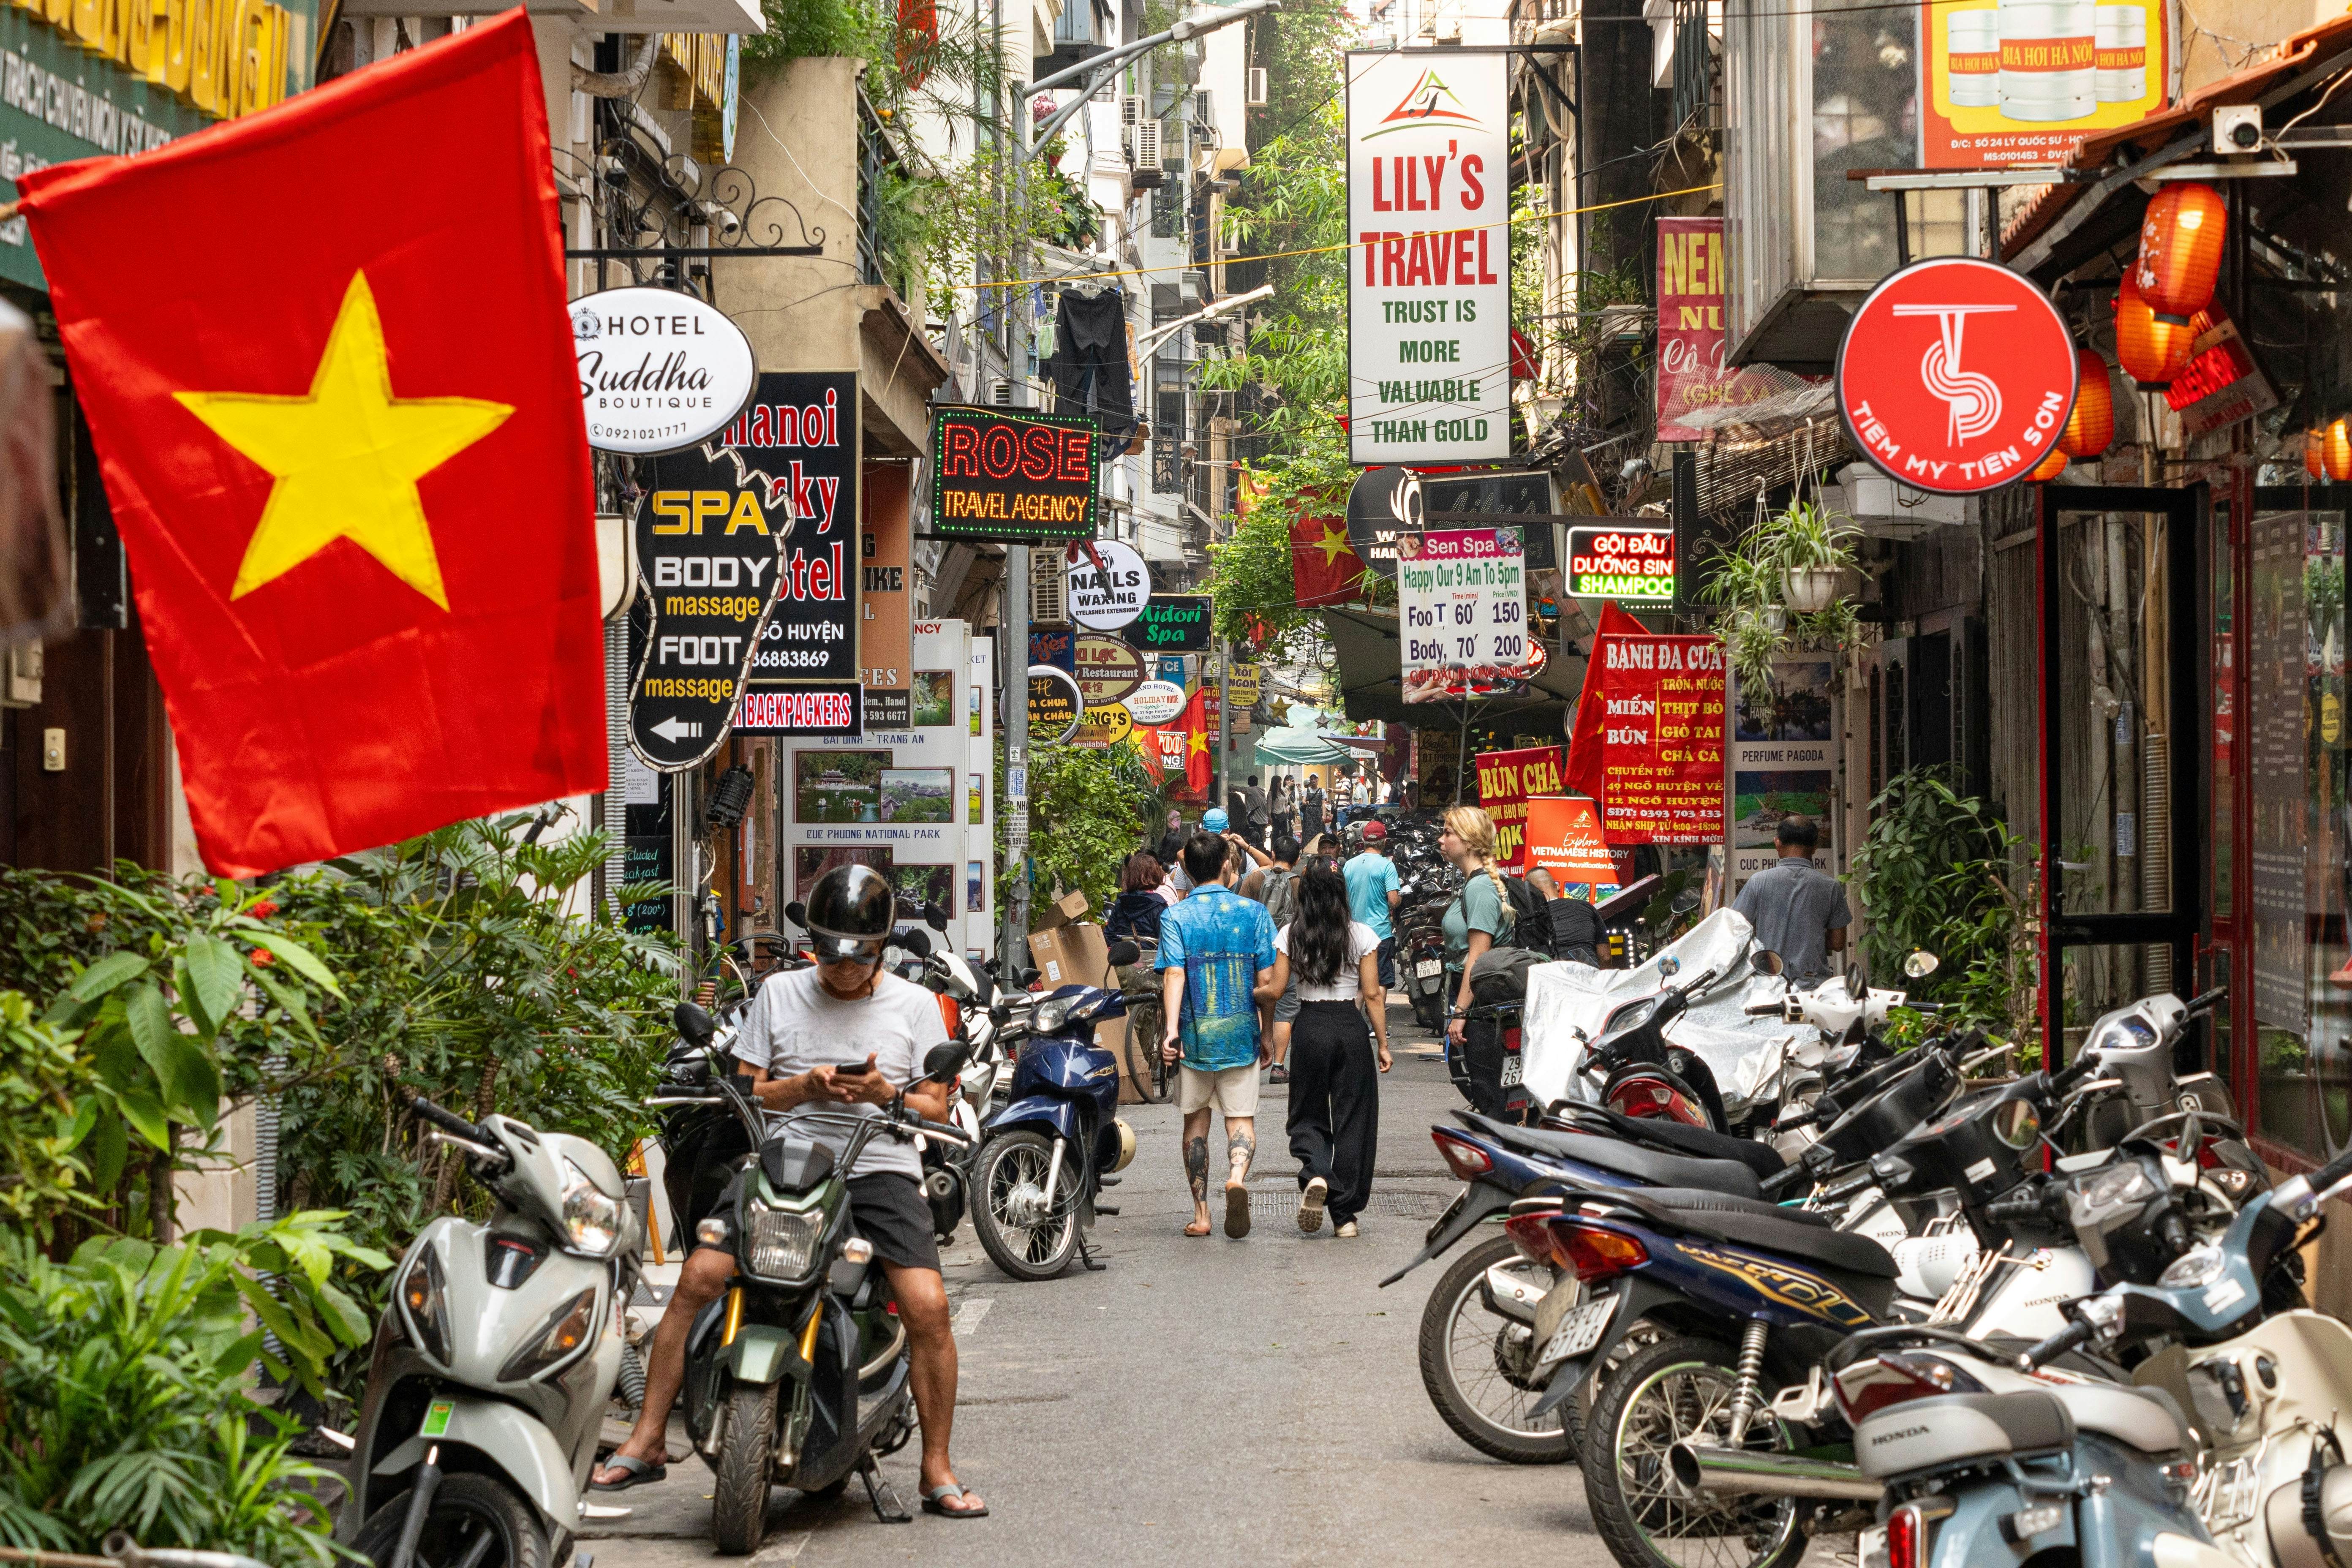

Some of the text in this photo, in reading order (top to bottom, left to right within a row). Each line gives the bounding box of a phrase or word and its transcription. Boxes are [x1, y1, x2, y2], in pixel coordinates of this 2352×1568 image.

[1950, 57, 1962, 69] BIA
[1982, 54, 1993, 69] HÀ
[2003, 40, 2092, 67] BIA HƠI HÀ NỘI
[2117, 49, 2128, 65] HÀ
[2130, 48, 2144, 66] NỘI
[1951, 139, 1971, 148] Đ/C:
[1975, 136, 1989, 147] SỐ
[2004, 136, 2015, 146] LÝ
[2018, 135, 2046, 145] QUỐC
[2048, 135, 2062, 144] SƯ
[1984, 152, 2038, 161] MS:0101453
[1373, 139, 1484, 211] LILY'S
[1360, 230, 1497, 287] TRAVEL
[1382, 299, 1476, 323] TRUST IS
[608, 316, 705, 335] HOTEL
[1399, 340, 1460, 363] MORE
[577, 351, 713, 399] Suddha
[1378, 379, 1481, 403] VALUABLE
[600, 397, 711, 408] BOUTIQUE
[606, 422, 686, 439] 0921021777
[1371, 419, 1488, 443] THAN GOLD
[943, 424, 1089, 481] ROSE
[653, 490, 771, 536] SPA
[944, 491, 1088, 522] TRAVEL AGENCY
[1427, 537, 1495, 558] Sen Spa
[1594, 533, 1625, 555] GỘI
[655, 557, 772, 587] BODY
[1573, 554, 1640, 574] DƯỠNG
[1404, 561, 1520, 593] Happy Our 9 Am To 5pm
[1464, 591, 1479, 600] (mins)
[1505, 590, 1519, 598] (VND)
[666, 596, 760, 622] massage
[1492, 601, 1520, 624] 150
[788, 621, 844, 644] HUYỆN
[1146, 624, 1185, 645] Spa
[660, 636, 741, 665] FOOT
[1110, 639, 1127, 649] SERVICE
[1410, 638, 1447, 664] Body,
[1494, 634, 1522, 657] 200
[1606, 638, 1654, 669] BÁNH
[1658, 645, 1683, 670] ĐA
[1082, 667, 1139, 678] Restaurant
[645, 678, 733, 704] massage
[1153, 684, 1175, 693] HOTEL
[1229, 678, 1257, 689] NGON
[1662, 676, 1693, 694] TRỘN,
[885, 696, 906, 706] Hanoi
[1134, 695, 1179, 704] HOLIDAY HOME
[1607, 694, 1724, 719] MIẾN THỊT BÒ
[746, 693, 851, 728] BACKPACKERS
[869, 710, 906, 721] 593 6677
[1043, 710, 1072, 720] CHÂU
[877, 735, 924, 744] TRANG AN
[1607, 723, 1721, 745] BÚN GIÒ TAI
[1073, 740, 1107, 748] available
[1661, 746, 1720, 762] CHẢ CÁ
[1742, 749, 1824, 762] PERFUME PAGODA
[1479, 749, 1562, 799] BÚN CHẢ
[1607, 763, 1675, 776] CHUYỂN TỪ:
[1624, 781, 1652, 790] NGÕ
[1655, 781, 1701, 793] HUYỆN
[1704, 780, 1724, 791] VỀ
[1628, 796, 1662, 805] NGÕ
[1666, 796, 1721, 807] HUYỆN
[1503, 804, 1517, 820] BBQ
[1606, 808, 1722, 818] SĐT: 0393 703 133
[1606, 818, 1633, 832] NHẬN
[1635, 820, 1656, 830] SHIP
[1658, 819, 1671, 830] TỪ
[1698, 822, 1720, 831] 18:00
[807, 829, 941, 839] CUC PHUONG NATIONAL PARK
[1563, 832, 1600, 849] Explore
[1673, 834, 1699, 843] KÍNH
[1701, 834, 1724, 843] MỜI!
[1531, 846, 1630, 859] VIETNAMESE HISTORY
[1537, 860, 1621, 871] Celebrate Reunification Day
[1740, 859, 1759, 871] CUC
[1419, 967, 1440, 977] 799.71
[1508, 1057, 1521, 1070] 29
[1504, 1070, 1522, 1086] 267
[2024, 1293, 2070, 1308] HONDA
[1871, 1425, 1930, 1447] HONDA
